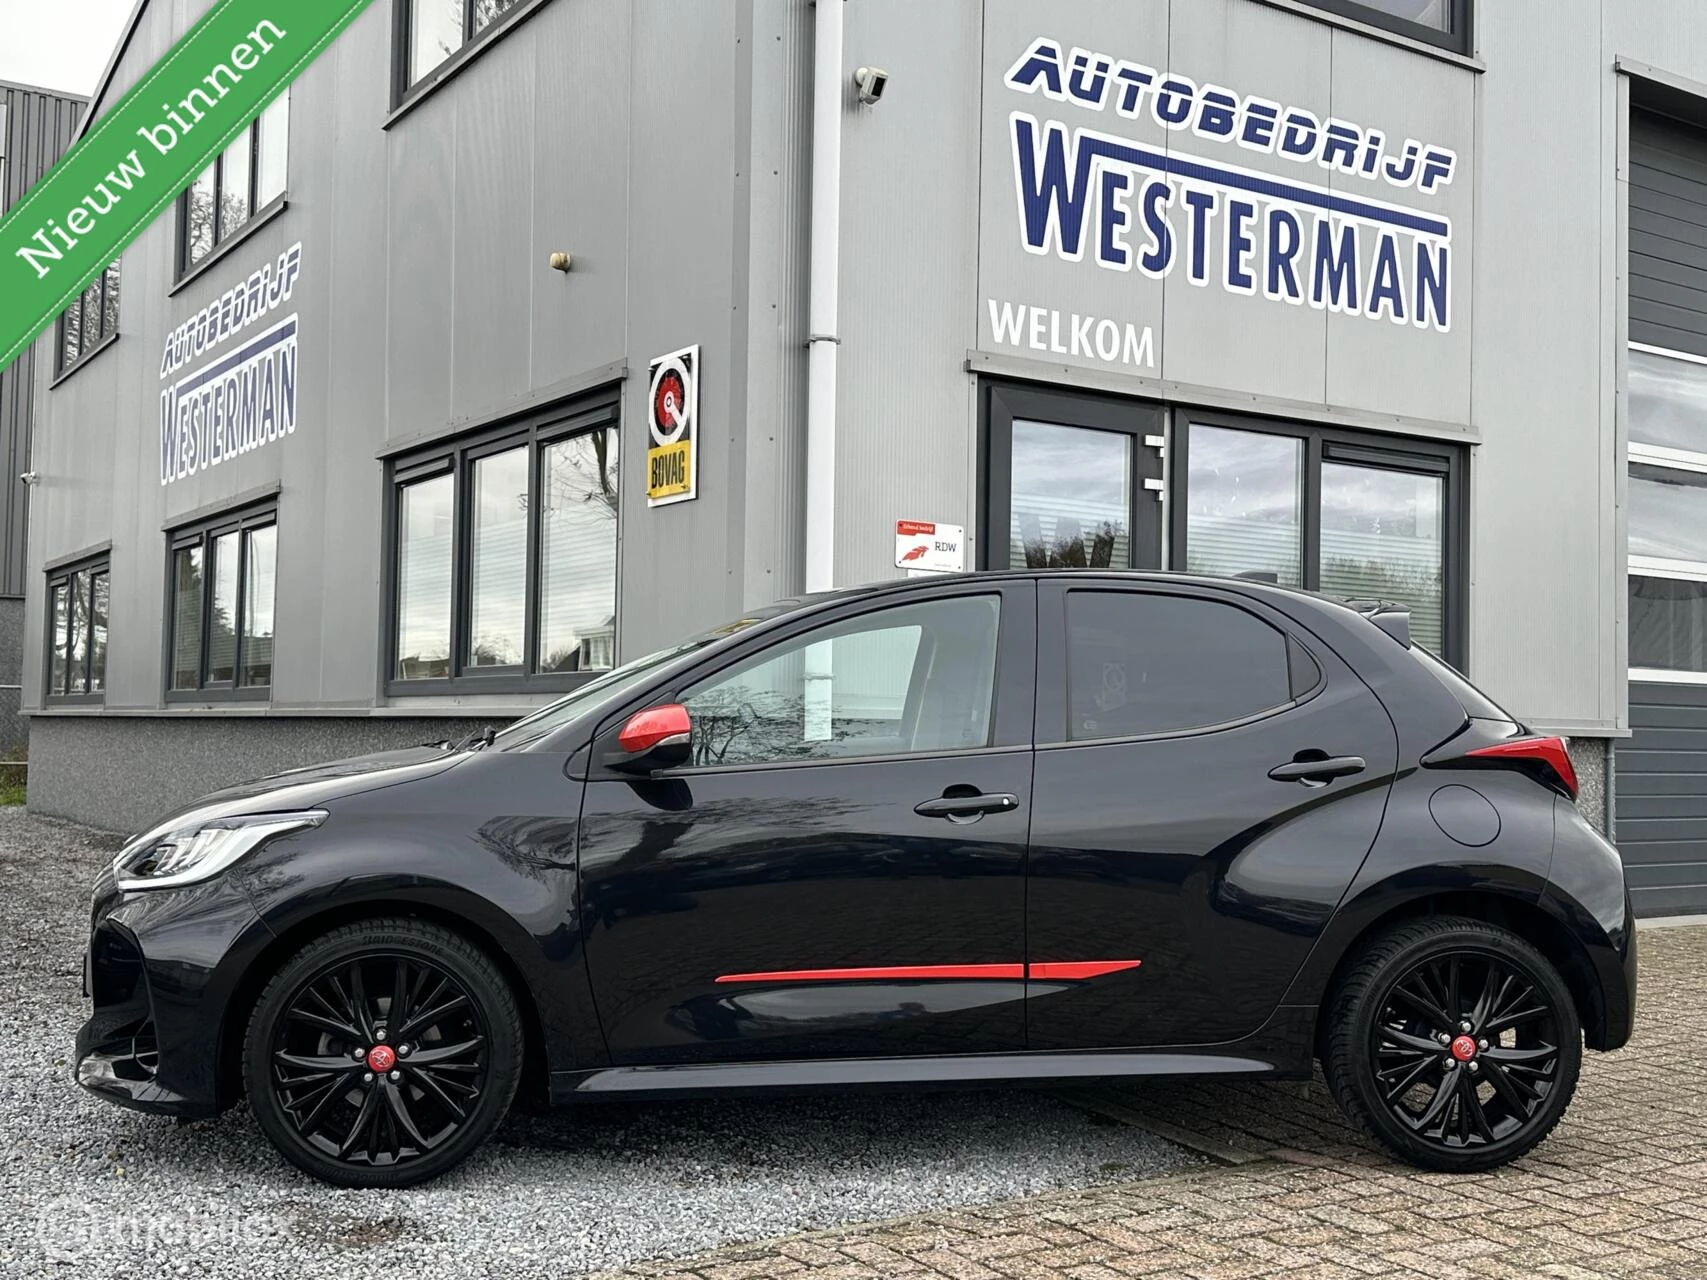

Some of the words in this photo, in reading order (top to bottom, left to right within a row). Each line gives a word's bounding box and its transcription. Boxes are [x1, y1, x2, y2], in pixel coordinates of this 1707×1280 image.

[1010, 112, 1453, 332] WESTERMAN
[988, 299, 1155, 368] WELKOM
[160, 313, 298, 486] WESTERMAN
[651, 449, 685, 489] BOVAG
[934, 541, 957, 552] RDW
